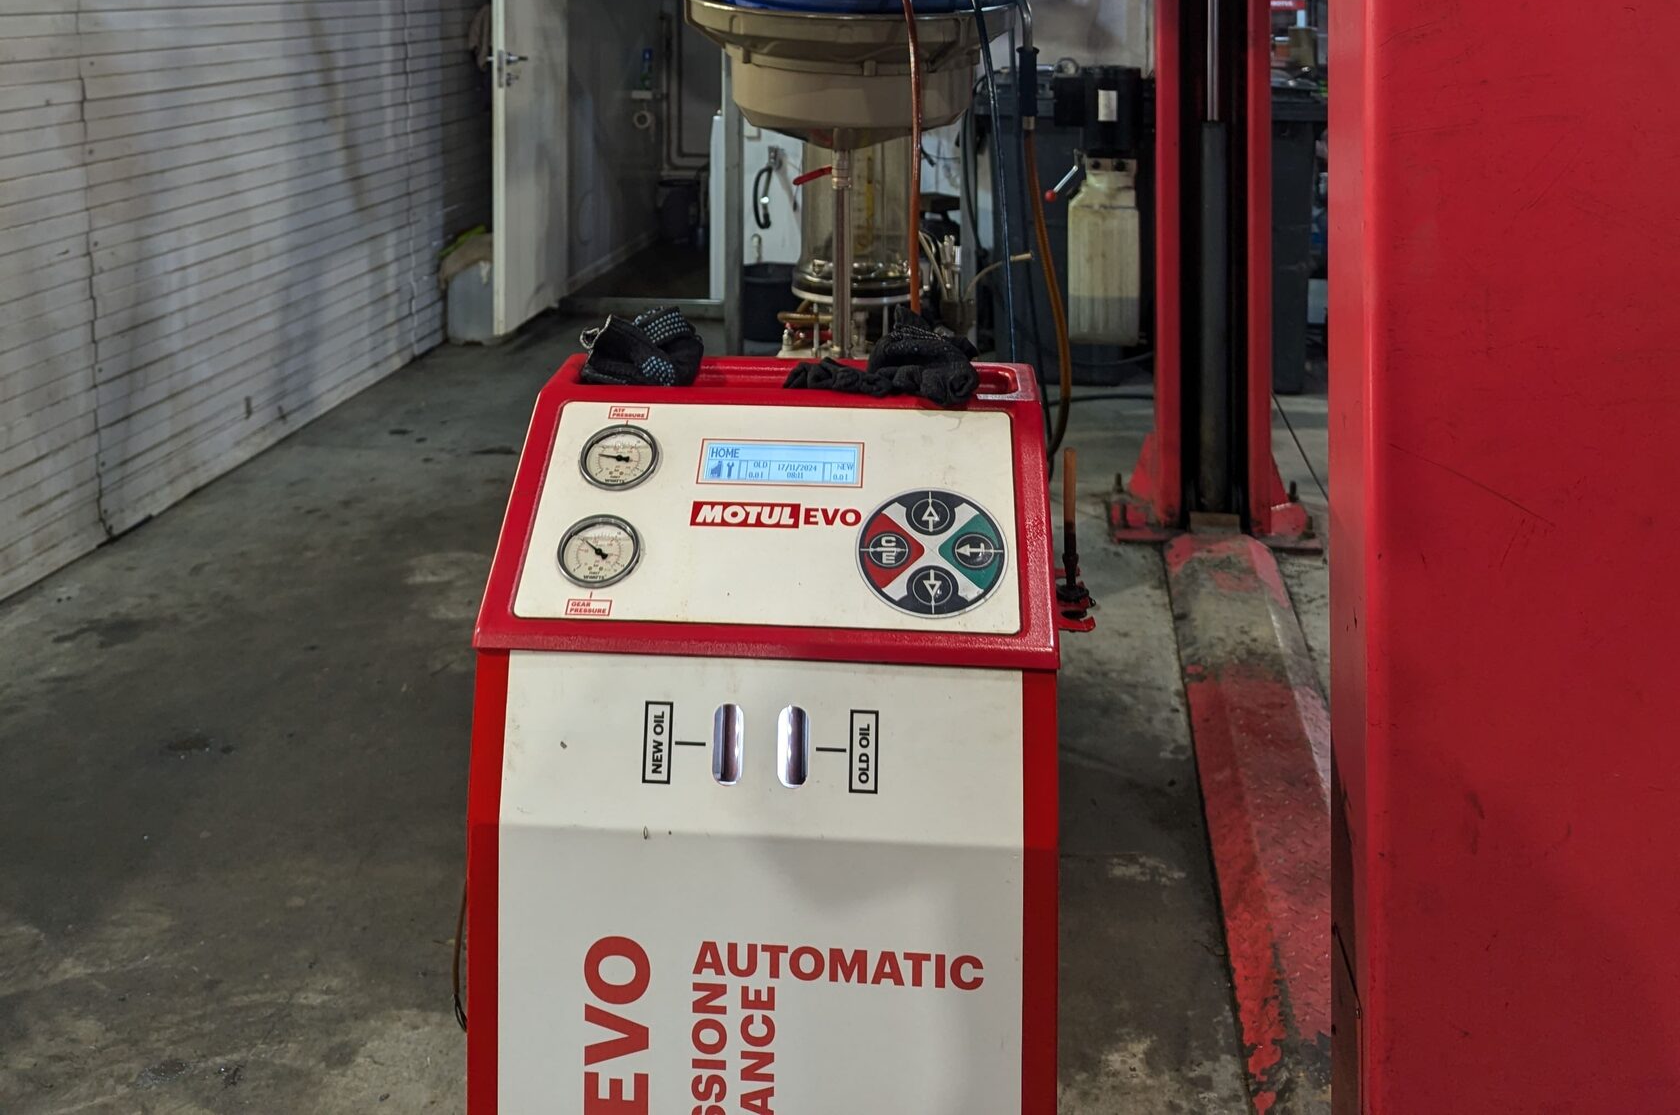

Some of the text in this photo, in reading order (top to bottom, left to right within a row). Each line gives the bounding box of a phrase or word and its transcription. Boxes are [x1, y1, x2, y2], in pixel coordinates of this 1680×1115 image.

[710, 447, 740, 458] HOME
[753, 461, 768, 469] OLD
[695, 504, 862, 527] MOTUL EVO
[651, 711, 665, 774] NEW OIL
[858, 723, 870, 784] OLD OIL
[692, 940, 984, 991] AUTOMATIC
[584, 936, 650, 1115] EVO
